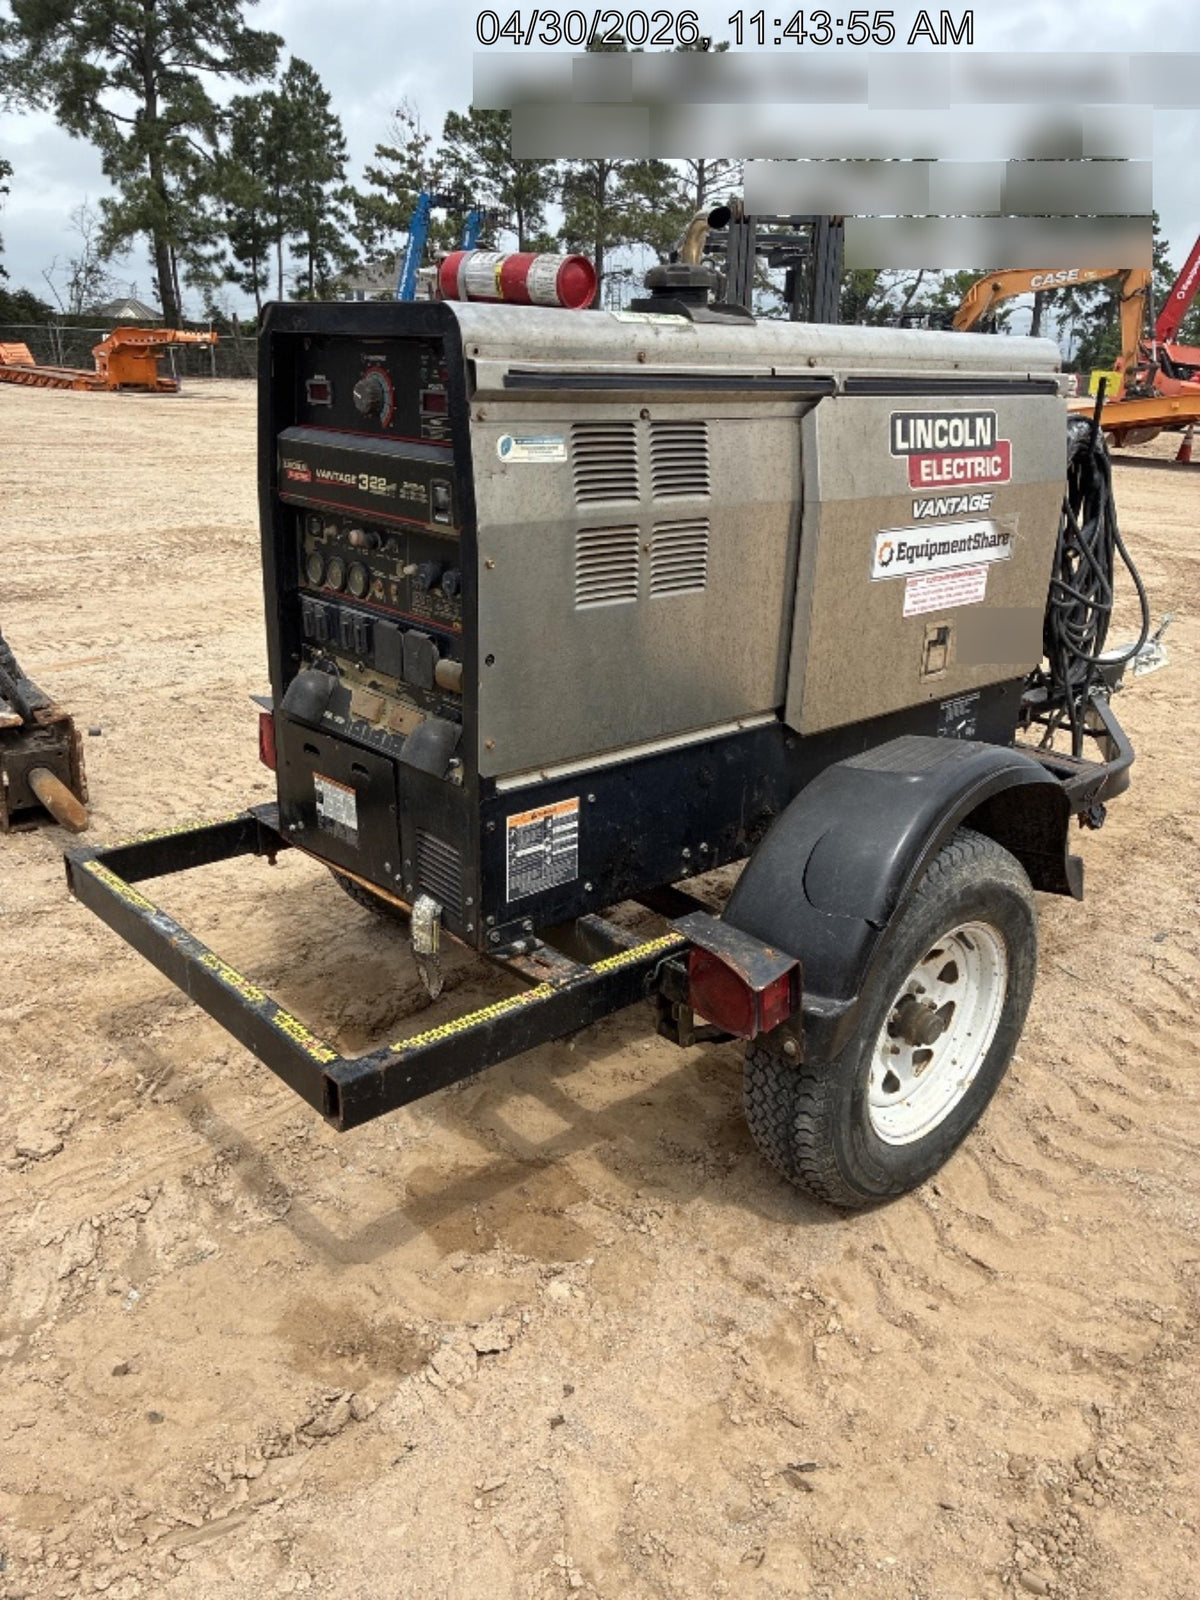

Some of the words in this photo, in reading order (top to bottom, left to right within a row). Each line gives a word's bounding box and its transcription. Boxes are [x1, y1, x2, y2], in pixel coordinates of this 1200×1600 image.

[1030, 268, 1080, 287] CASE
[895, 416, 992, 451] LINCOLN
[316, 468, 357, 484] VANTAGE
[920, 455, 1002, 482] ELECTRIC
[912, 493, 994, 519] VANTAGE
[896, 532, 1011, 563] EquipmentShare
